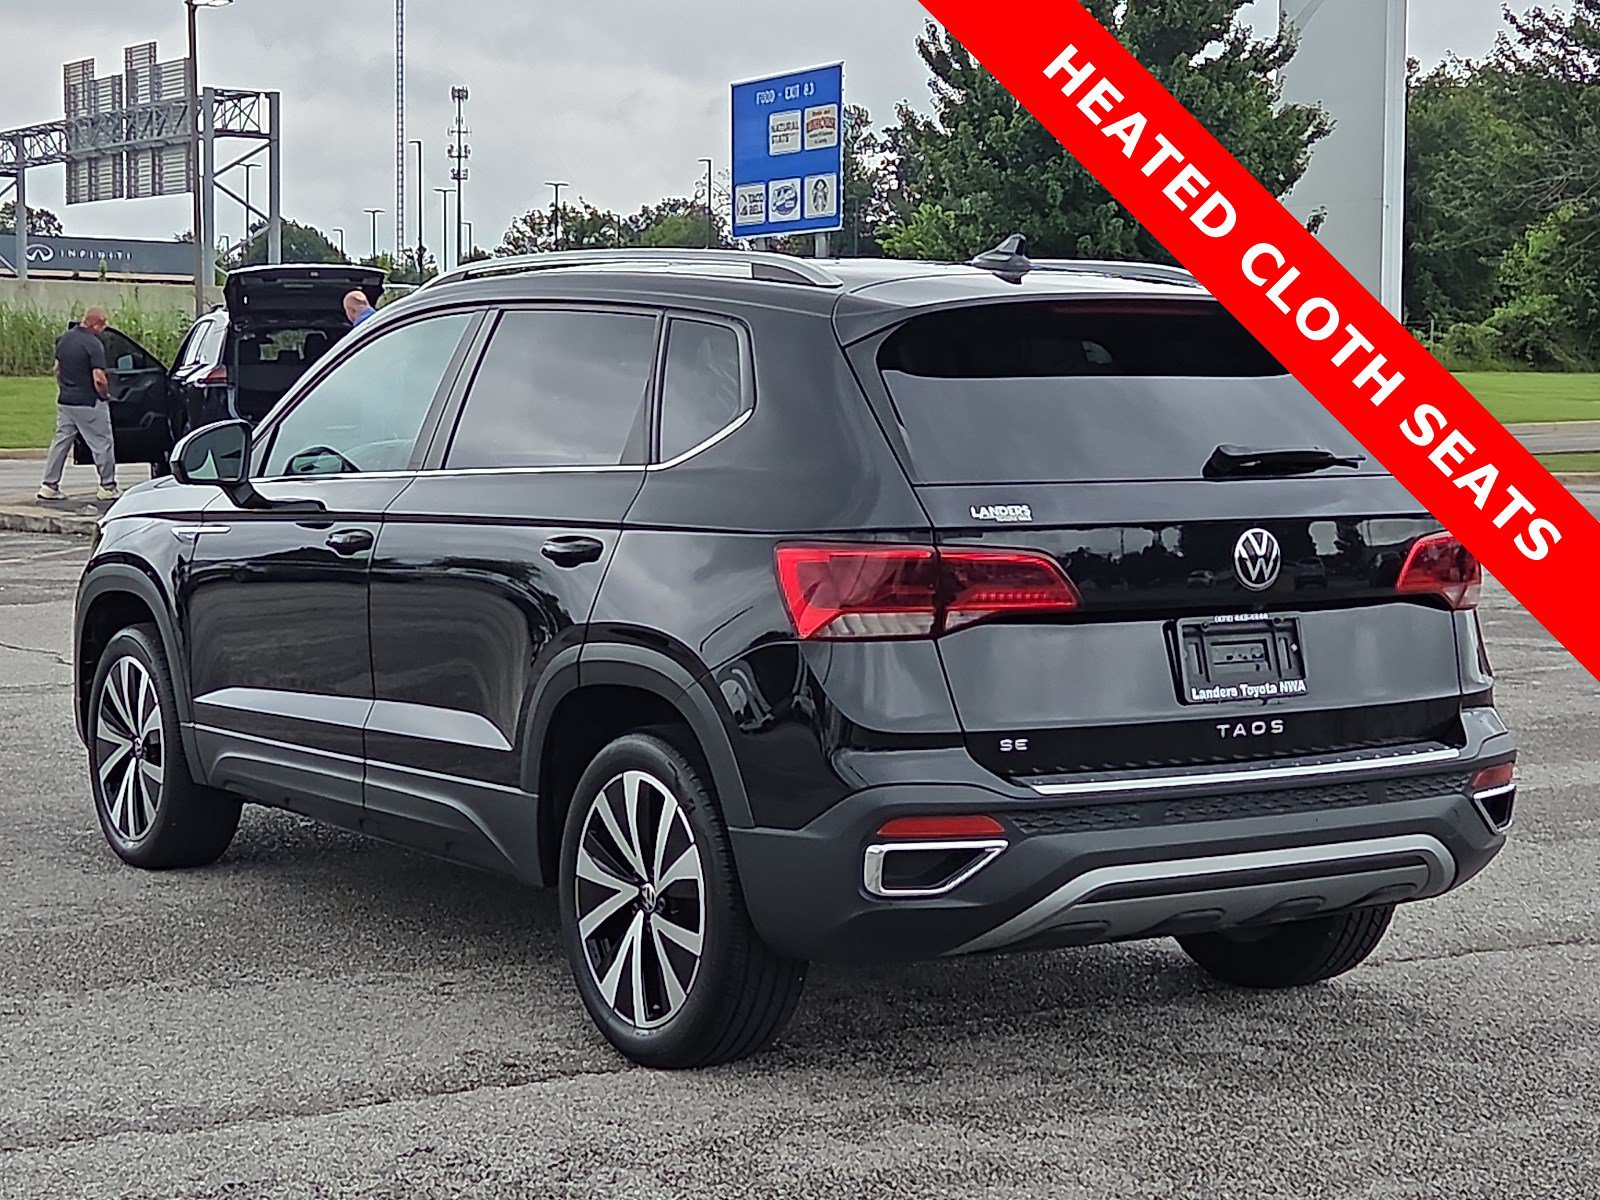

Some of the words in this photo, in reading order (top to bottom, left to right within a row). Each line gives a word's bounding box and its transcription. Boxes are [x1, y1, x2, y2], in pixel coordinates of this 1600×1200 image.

[59, 249, 132, 260] INFINITI
[970, 504, 1031, 519] LANDERS
[1191, 685, 1238, 701] Landers
[1239, 682, 1278, 698] Toyota
[1279, 679, 1307, 694] NWA
[1216, 719, 1285, 739] TAOS
[1000, 738, 1029, 752] SE
